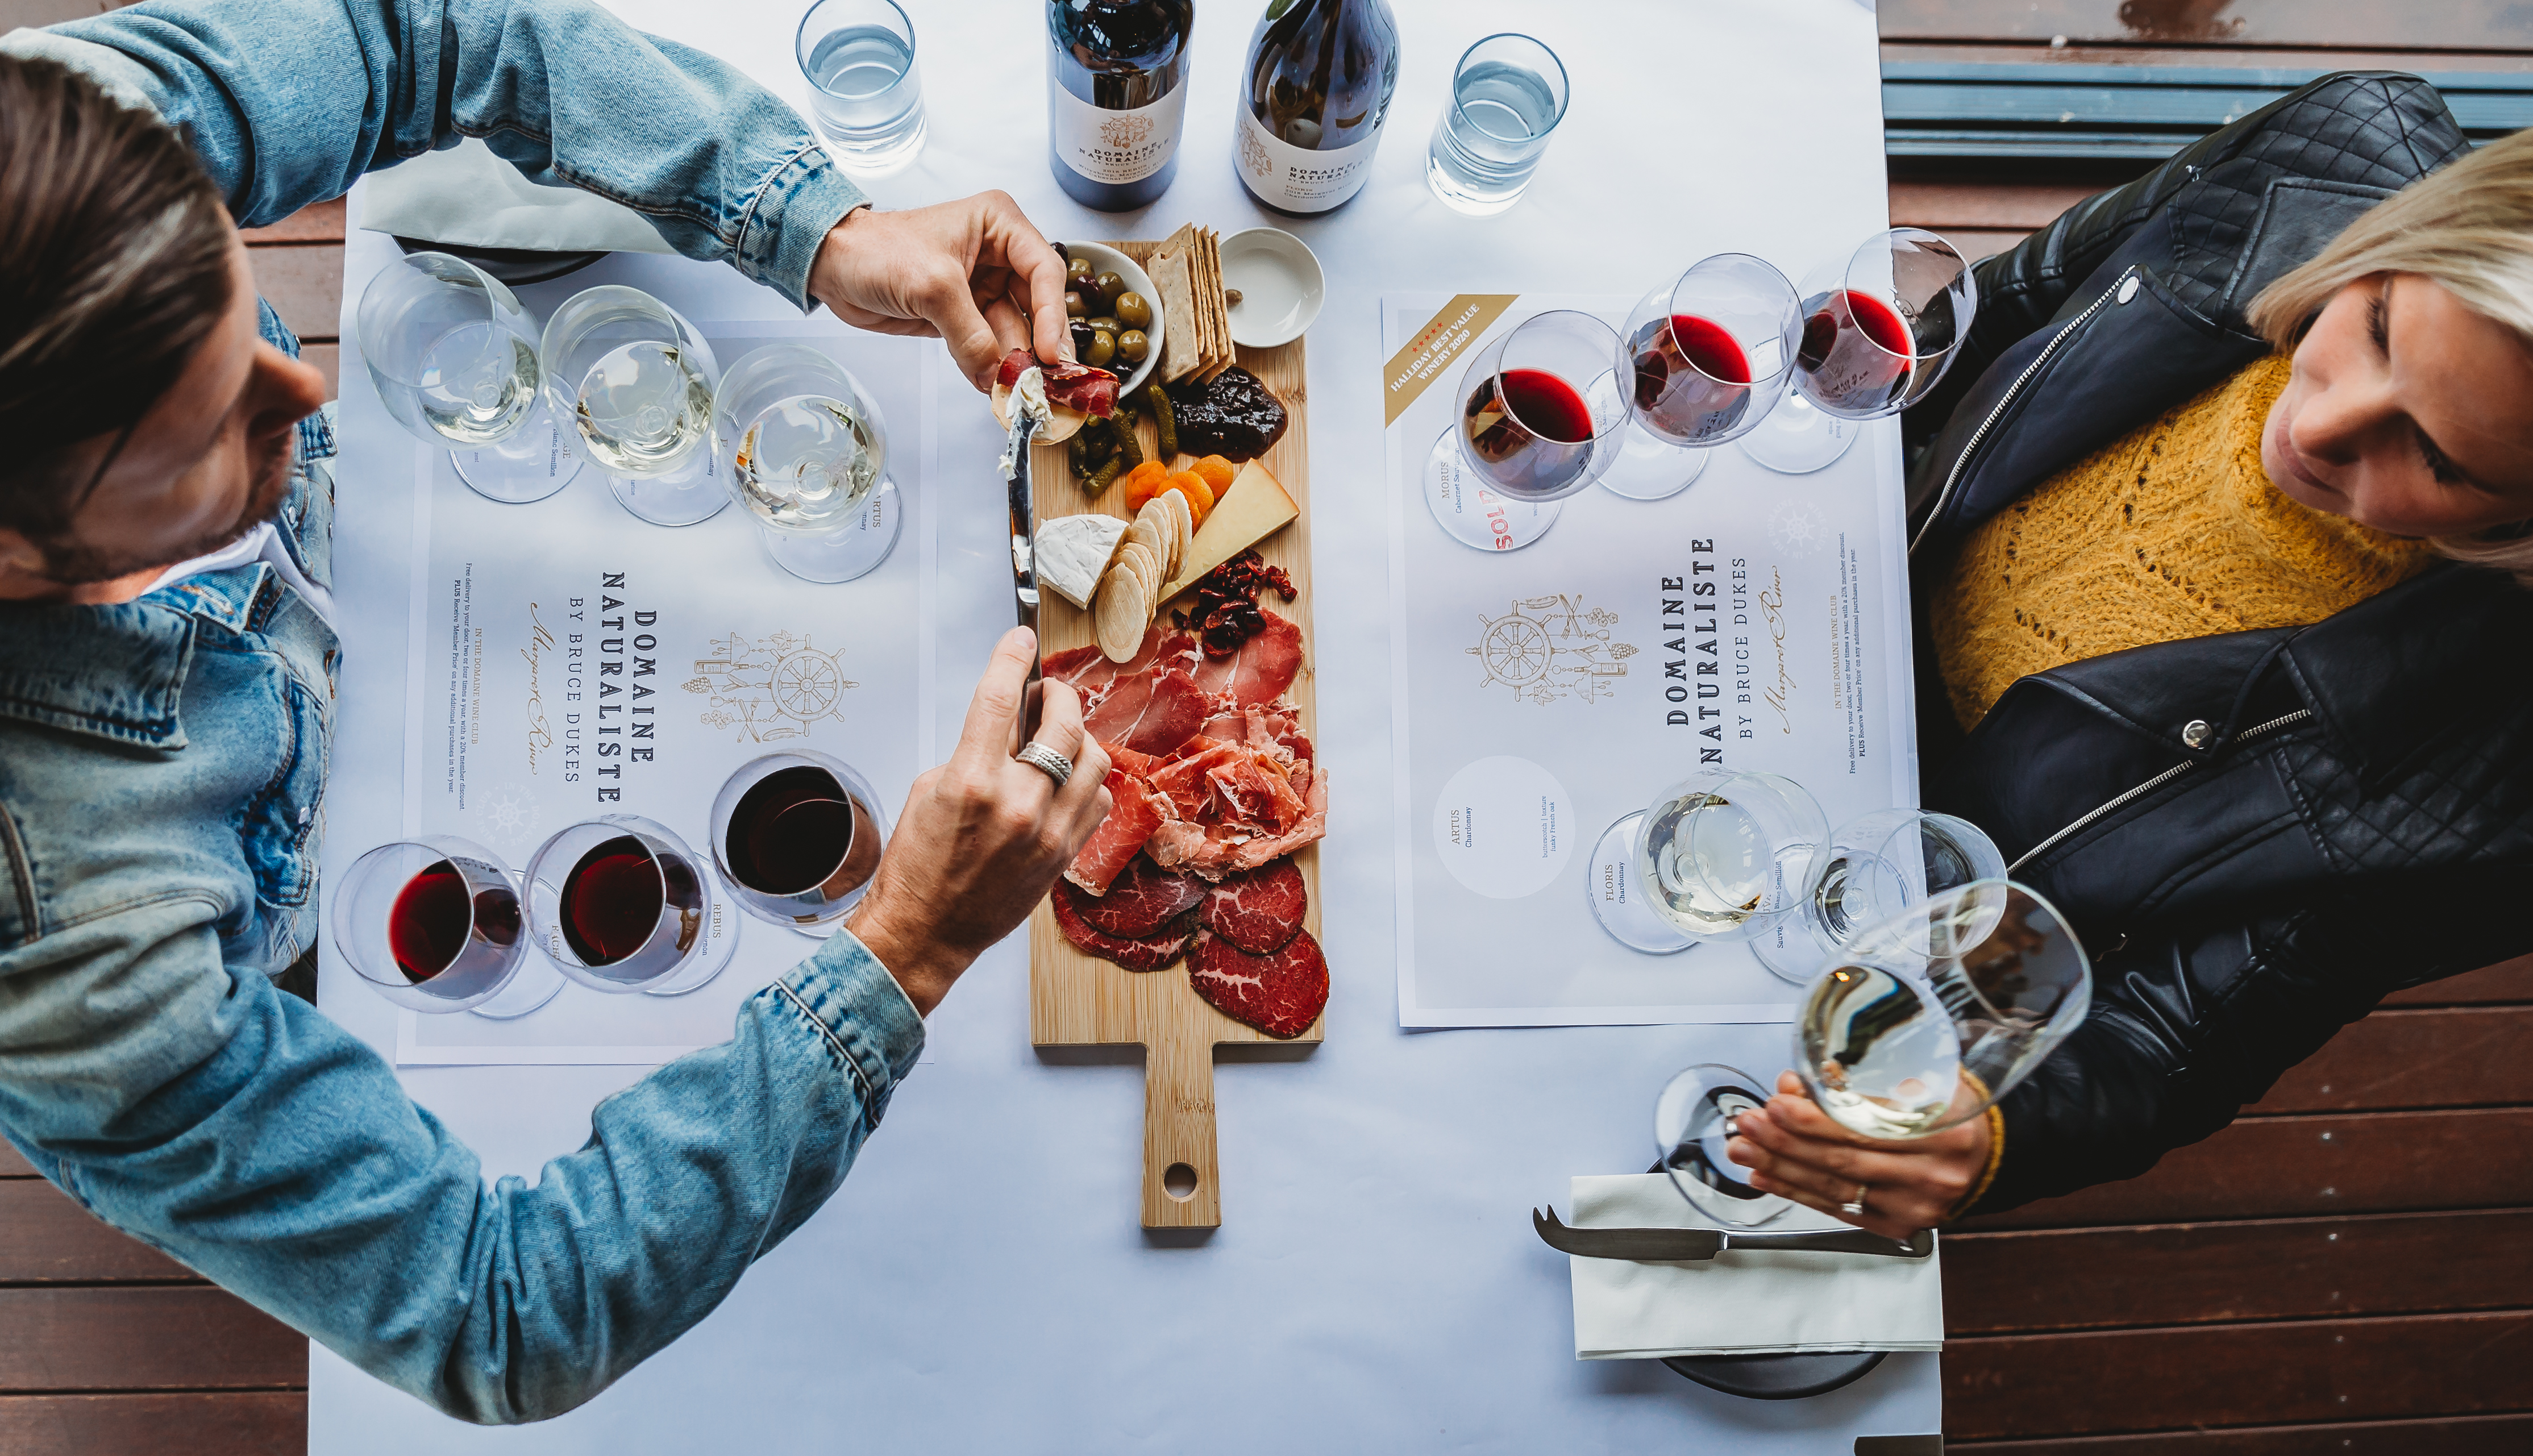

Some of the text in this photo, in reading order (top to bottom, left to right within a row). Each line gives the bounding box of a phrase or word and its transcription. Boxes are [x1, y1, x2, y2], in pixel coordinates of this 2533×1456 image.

[1079, 138, 1169, 163] NATURALISTE
[1094, 142, 1157, 156] DOMAINE
[1290, 162, 1353, 174] DOMAINE
[1390, 303, 1480, 392] HALLIDAY BEST VALUE
[1417, 329, 1470, 380] WINERY 2020
[1441, 462, 1449, 499] MORUS
[1478, 490, 1513, 550] SOLD
[475, 628, 482, 637] IN
[1662, 576, 1688, 726] DOMAINE
[1692, 539, 1722, 764] NATURALISTE
[1732, 558, 1752, 739] BY BRUCE DUKES
[1758, 565, 1796, 734] Margaret River
[521, 602, 555, 775] Margaret River
[565, 597, 583, 783] BY BRUCE DUKES
[598, 572, 625, 802] NATURALISTE
[631, 610, 657, 762] DOMAINE
[1835, 700, 1841, 709] IN
[1451, 810, 1459, 845] ARTUS
[1605, 864, 1613, 901] FLORIS
